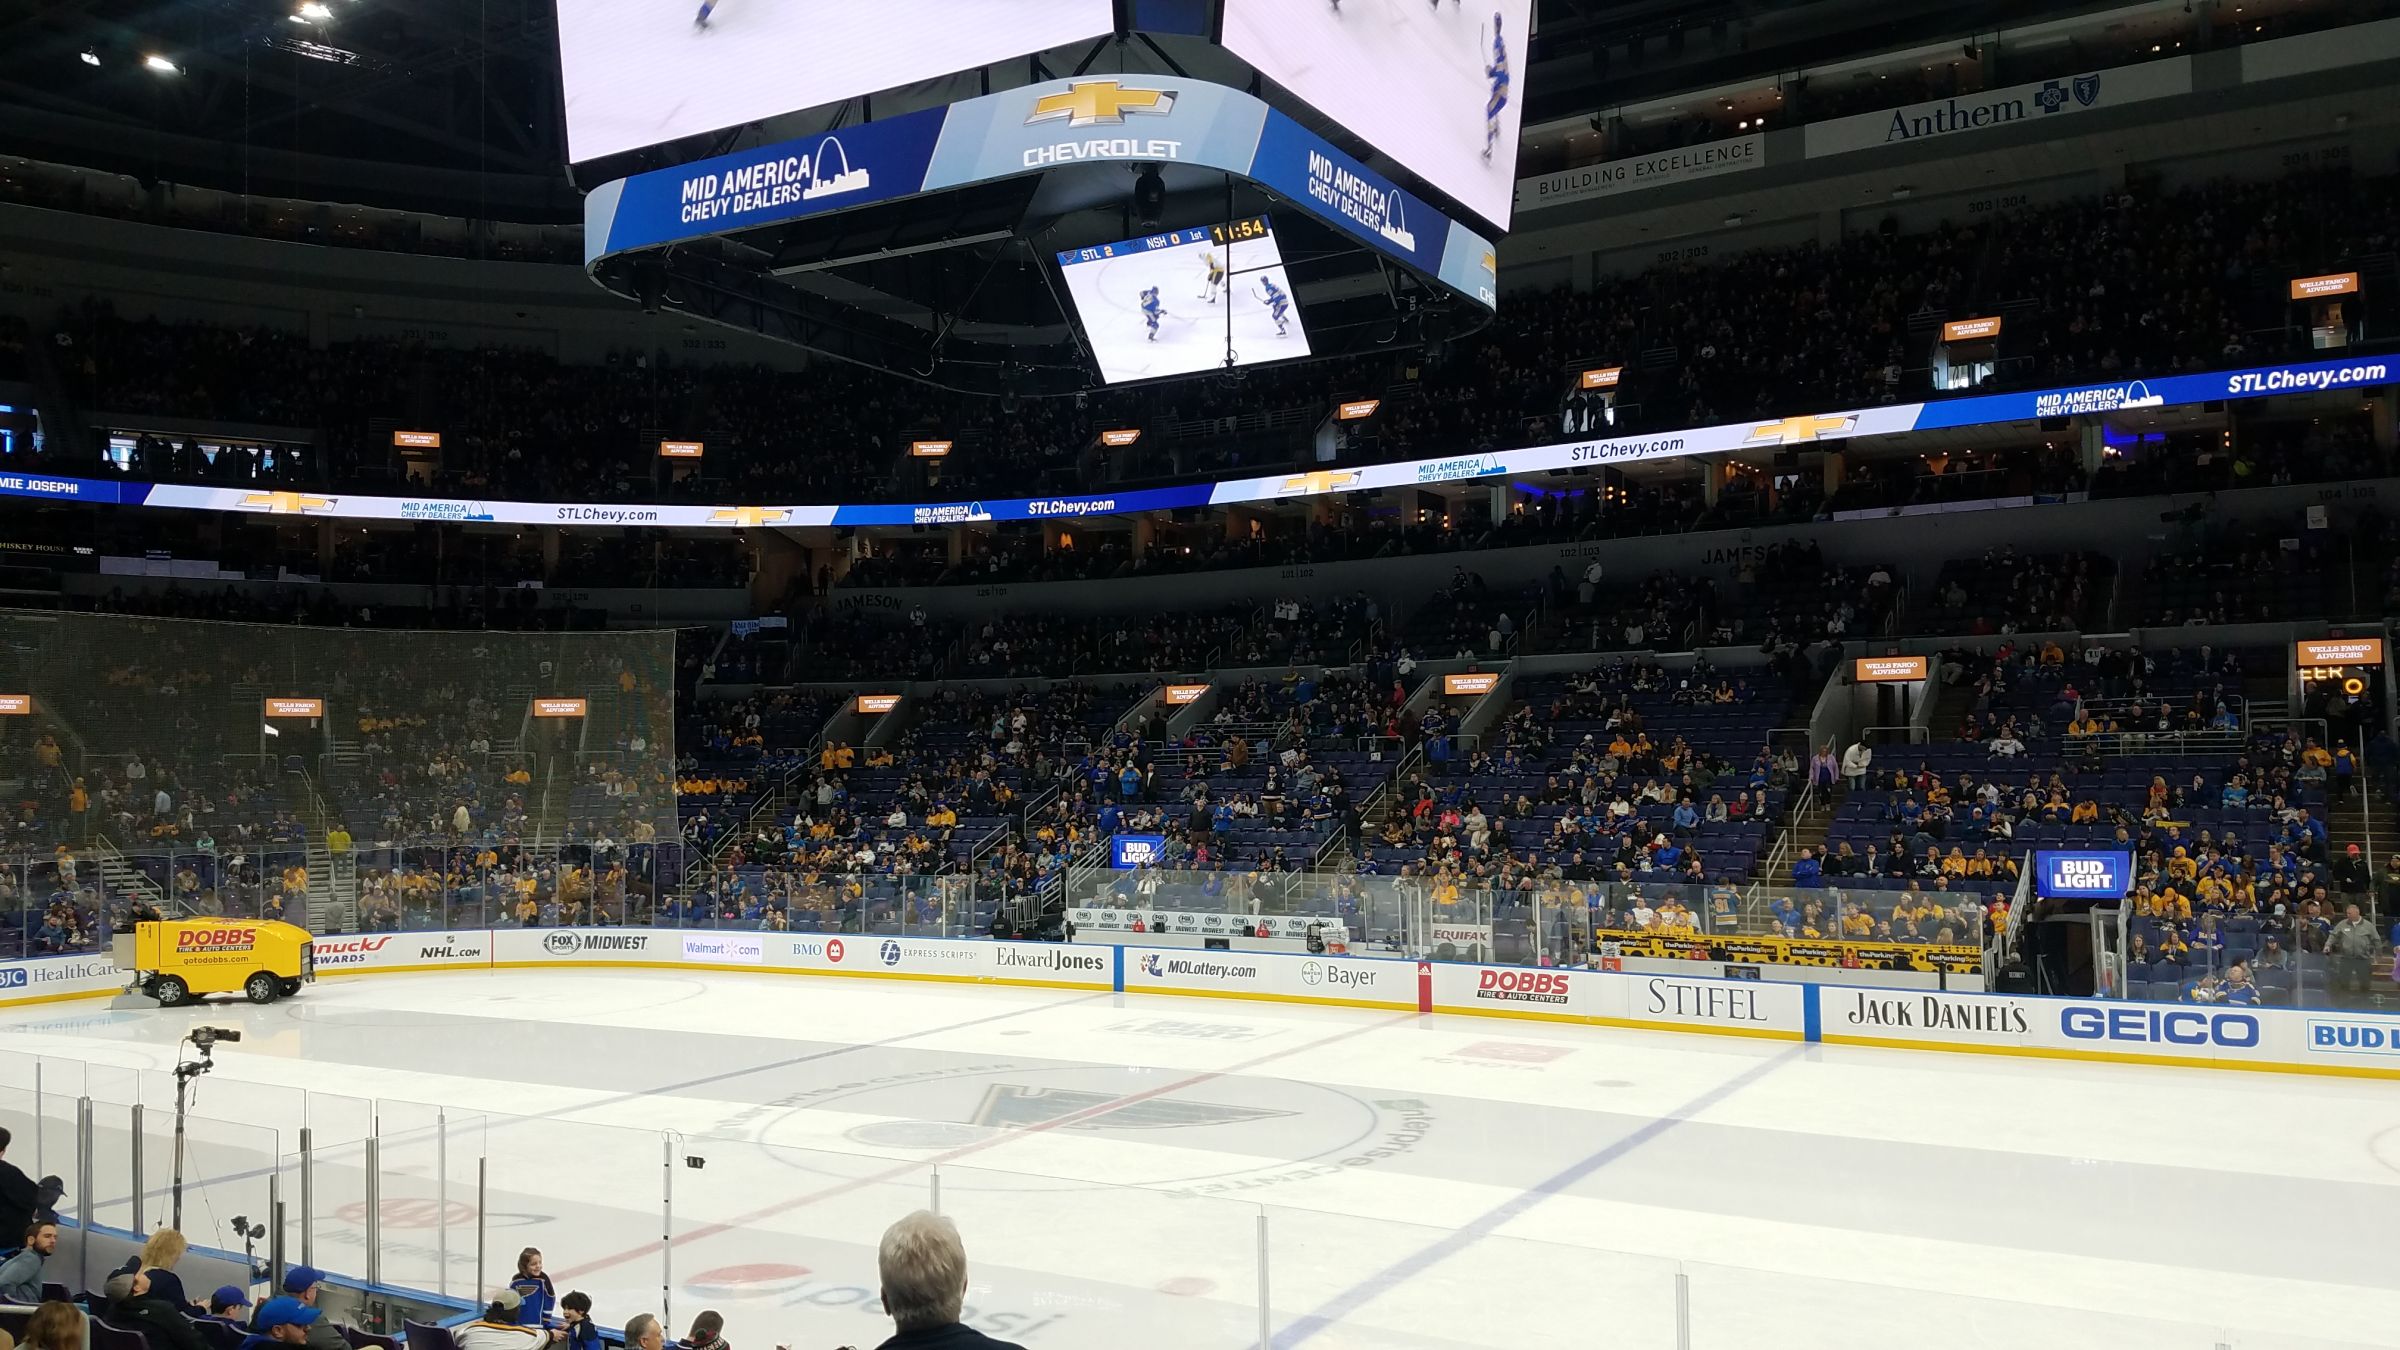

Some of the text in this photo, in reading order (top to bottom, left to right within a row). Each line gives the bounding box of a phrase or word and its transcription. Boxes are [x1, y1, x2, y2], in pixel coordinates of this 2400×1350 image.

[1886, 99, 2026, 142] Anthem
[1024, 138, 1182, 167] CHEVROLET
[1540, 143, 1754, 195] BUILDING EXCELLENCE
[681, 154, 811, 205] MID AMERICA
[1308, 149, 1386, 217] MID AMERICA
[681, 183, 802, 225] CHEVY DEALERS
[1308, 177, 1380, 232] CHEVY DEALERS
[1081, 248, 1101, 262] STL
[1105, 246, 1113, 257] 2
[1146, 236, 1168, 250] NSH
[1170, 234, 1180, 246] 0
[1213, 219, 1264, 242] 11:54
[2299, 278, 2350, 289] WELLS FARGO
[2306, 284, 2343, 293] ADVISORS
[2228, 364, 2386, 394] STLChevy.com
[2036, 387, 2125, 408] MID AMERICA
[2036, 399, 2119, 417] CHEVY DEALERS
[1571, 438, 1684, 461] STLChevy.com
[1418, 459, 1480, 475] MID AMERICA
[1418, 468, 1475, 482] CHEVY DEALERS
[26, 480, 78, 494] JOSEPH!
[401, 502, 467, 513] MID AMERICA
[401, 510, 462, 520] CHEVY DEALERS
[557, 507, 658, 523] STLChevy.com
[914, 505, 969, 517] MID AMERICA
[1029, 499, 1115, 515] STLChevy.com
[837, 594, 902, 612] JAMESON
[2308, 644, 2372, 653] WELLS FARGO
[2316, 652, 2363, 660] ADVISORS
[1892, 661, 1918, 669] FARGO
[1125, 842, 1151, 853] BUD
[2061, 859, 2105, 875] BUD
[2054, 873, 2113, 890] LIGHT
[177, 928, 257, 947] DOBBS
[551, 935, 573, 946] FOX
[583, 935, 648, 950] MIDWEST
[1433, 929, 1488, 942] EQUIFAX
[686, 942, 760, 956] Walmart com
[793, 943, 822, 956] BMO
[904, 948, 975, 960] EXPRESS SCRIPTS
[183, 956, 249, 965] gotodobbs.com
[1168, 960, 1257, 979] MOLottery.com
[1328, 965, 1377, 989] Bayer
[1479, 969, 1569, 995] DOBBS
[1479, 990, 1496, 998] TIRE
[1507, 992, 1528, 1001] AUTO
[1530, 994, 1566, 1003] CENTERS
[1648, 978, 1768, 1022] STIFEL
[1848, 992, 1913, 1027] JACK
[2060, 1006, 2260, 1049] GEICO
[2314, 1024, 2385, 1049] BUD
